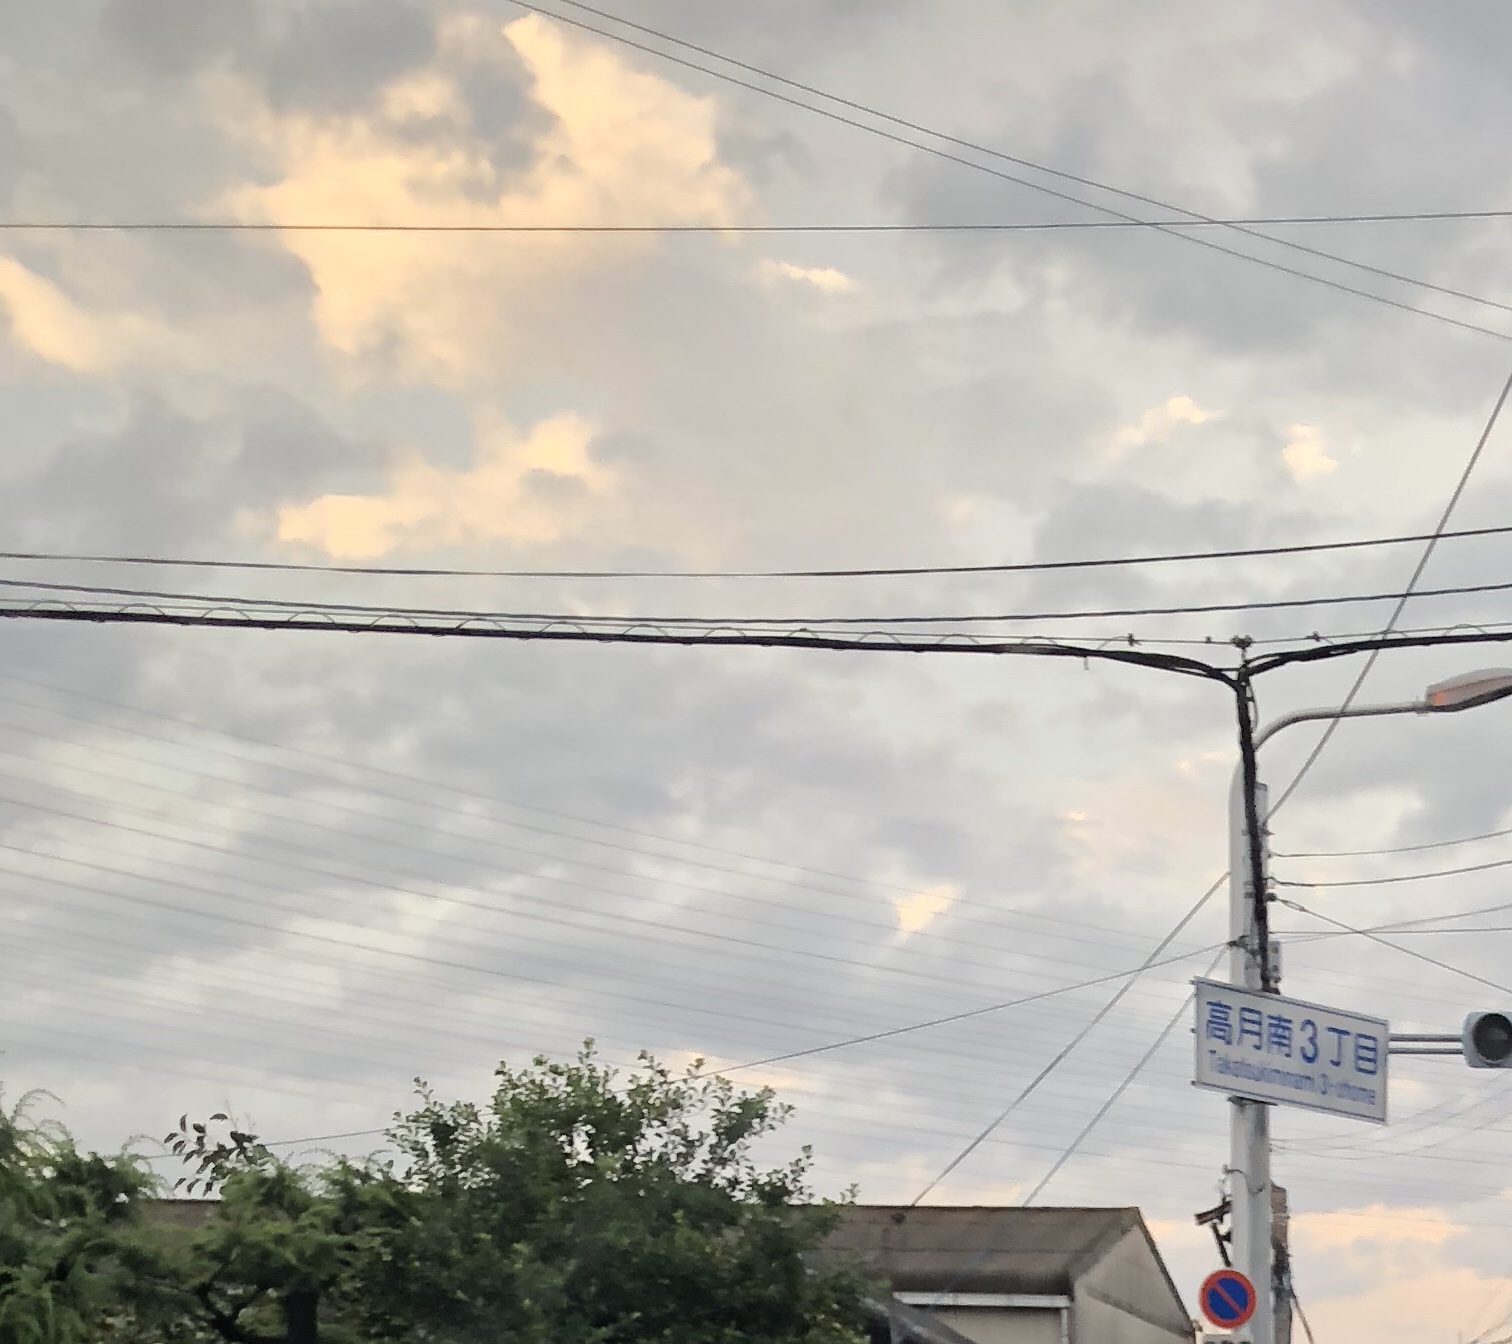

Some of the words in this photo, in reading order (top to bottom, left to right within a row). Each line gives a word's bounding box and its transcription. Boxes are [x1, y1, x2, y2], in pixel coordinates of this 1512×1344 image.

[1206, 1001, 1378, 1075] 高月南3丁目
